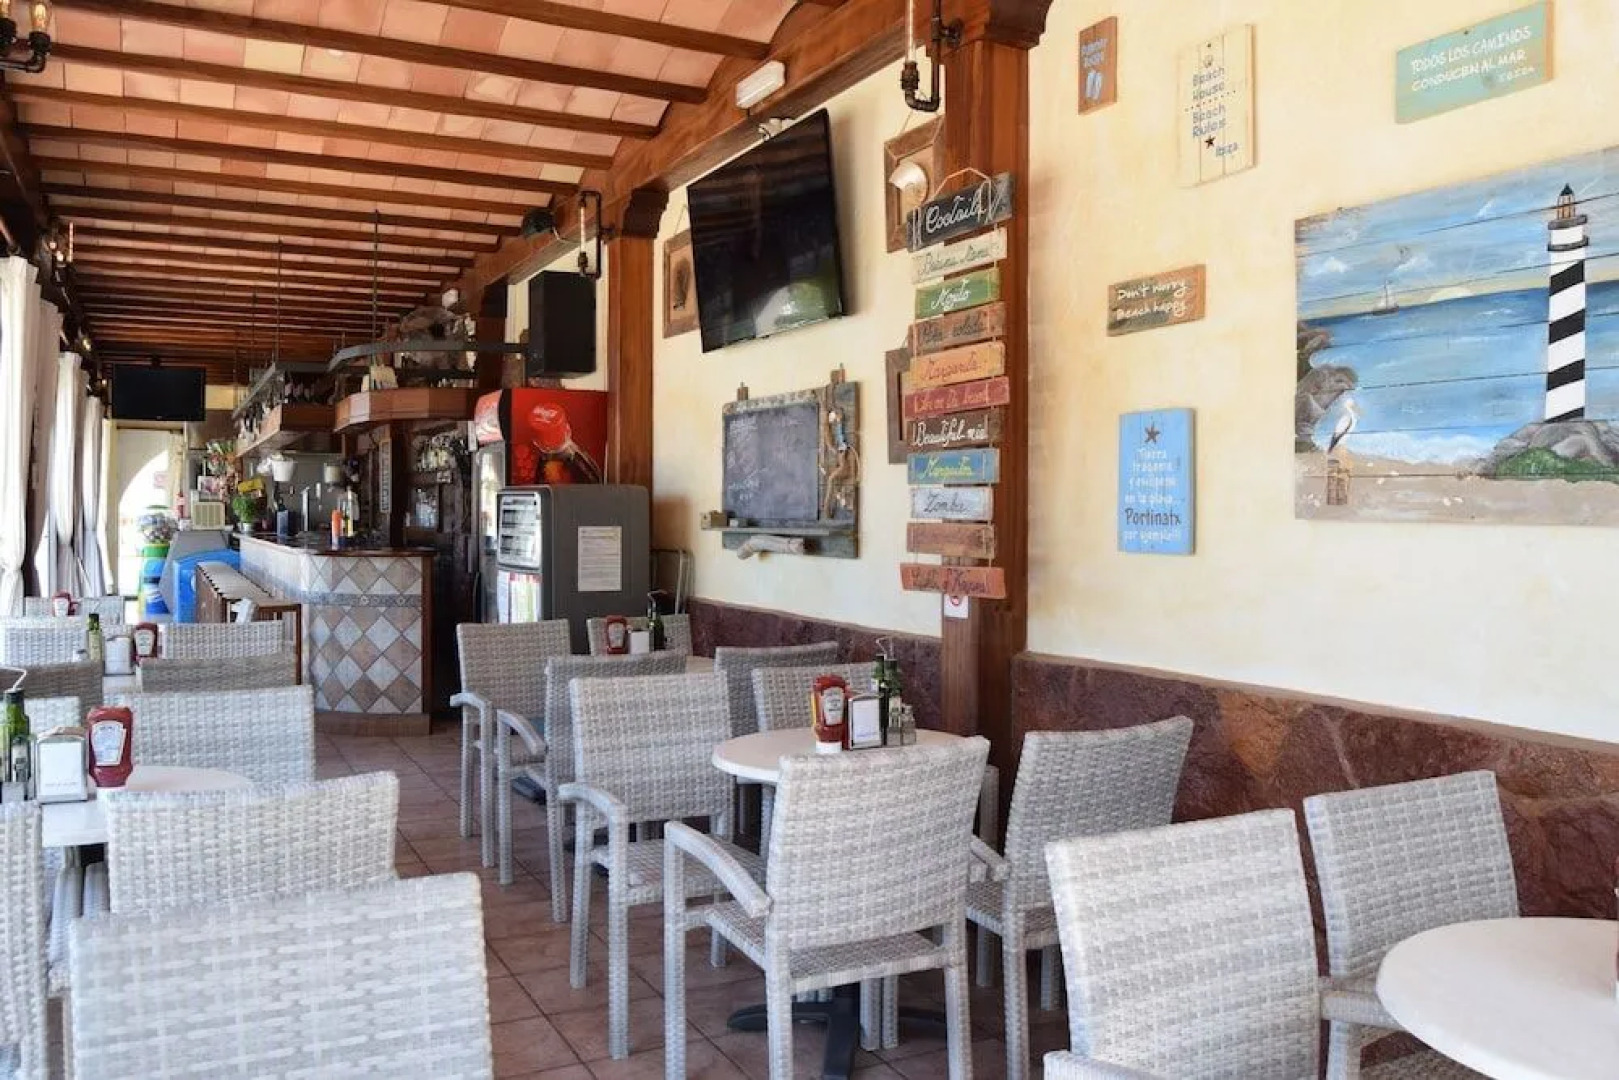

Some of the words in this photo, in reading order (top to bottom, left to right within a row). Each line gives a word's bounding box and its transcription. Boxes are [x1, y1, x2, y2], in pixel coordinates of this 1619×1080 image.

[1411, 52, 1447, 74] TODOS
[1449, 44, 1471, 62] LOS
[1473, 25, 1532, 54] CAMINOS
[1411, 62, 1479, 91] CONDUCEN
[1481, 59, 1497, 73] AL
[1498, 50, 1527, 66] MAR
[1193, 104, 1226, 124] Beach
[1123, 507, 1182, 526] Portinatx
